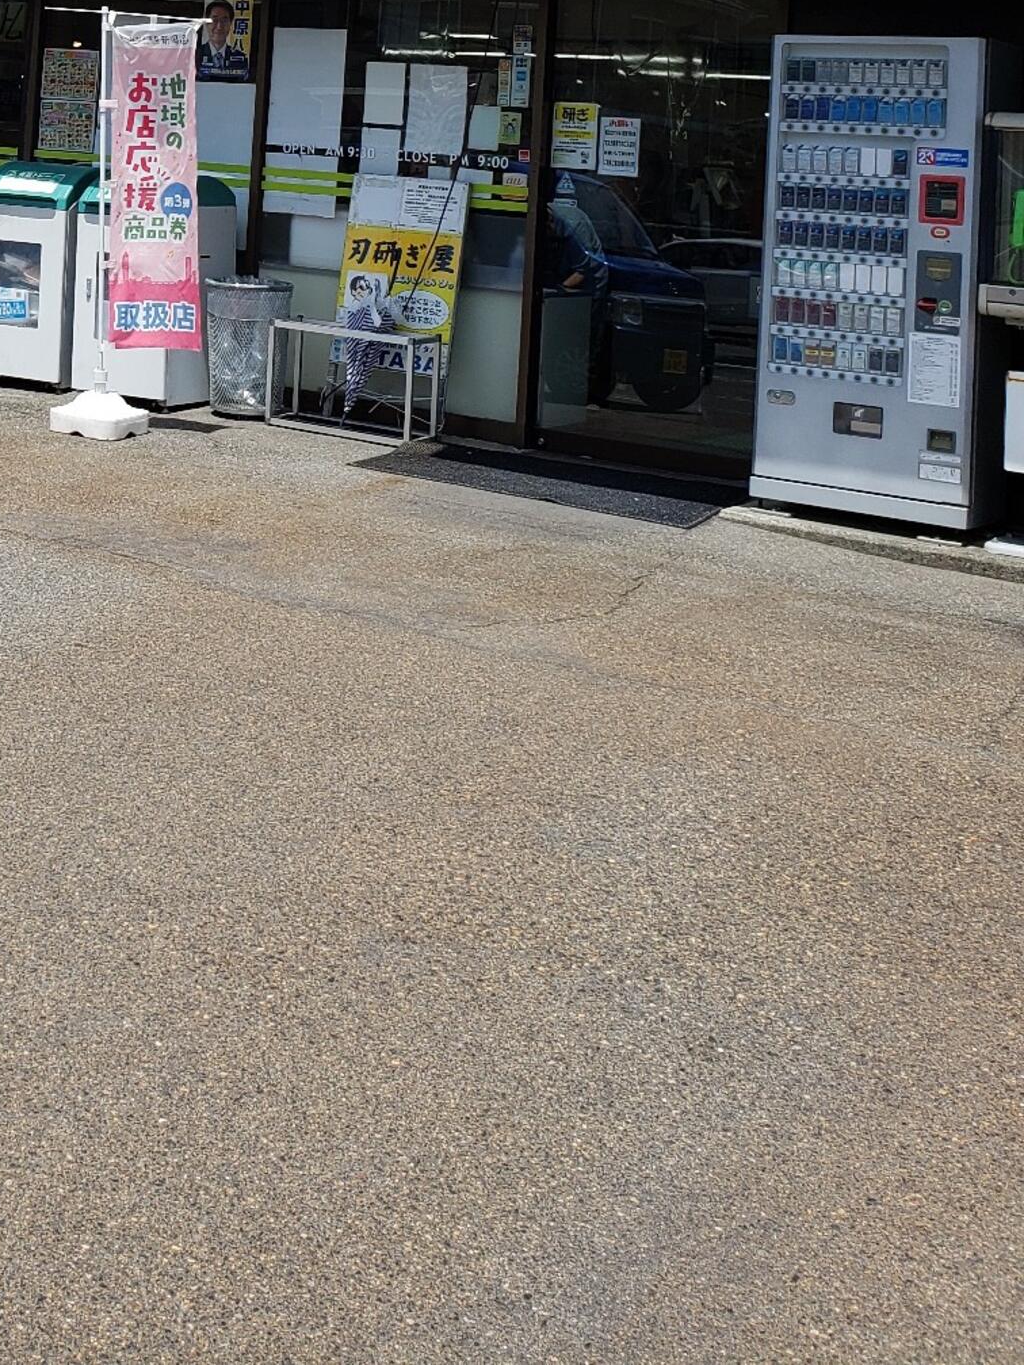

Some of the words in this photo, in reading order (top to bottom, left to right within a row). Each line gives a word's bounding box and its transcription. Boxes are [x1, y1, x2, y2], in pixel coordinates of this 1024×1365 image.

[160, 74, 186, 150] 地域の
[124, 72, 158, 211] お店応援
[282, 142, 315, 155] OPEN
[325, 147, 344, 158] AM
[347, 147, 375, 159] 9:30
[396, 150, 437, 165] CLOSE
[477, 155, 510, 170] 9:00
[124, 214, 187, 241] 商品券
[348, 238, 455, 274] 刃研ぎ屋
[115, 302, 196, 331] 取扱店
